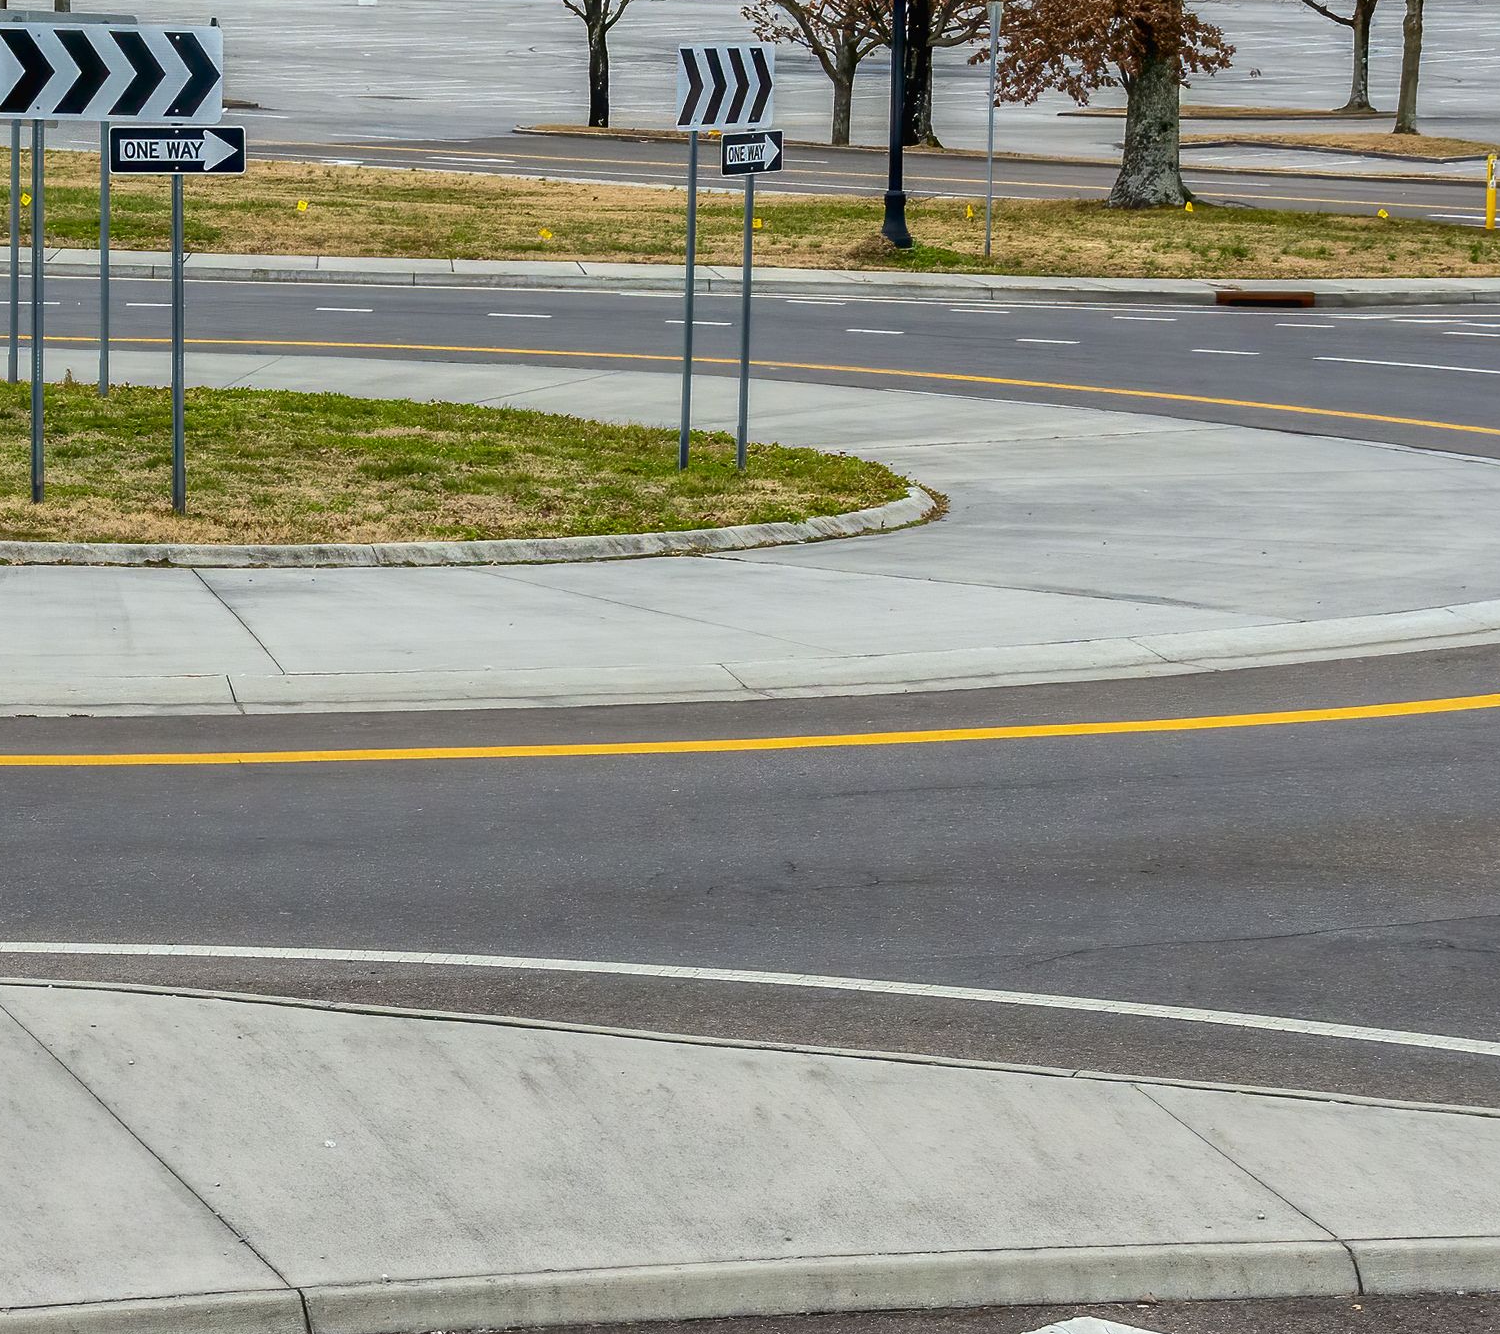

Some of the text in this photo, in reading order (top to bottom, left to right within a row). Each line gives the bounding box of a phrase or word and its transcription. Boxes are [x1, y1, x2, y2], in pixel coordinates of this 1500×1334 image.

[124, 141, 204, 159] ONE WAY
[728, 144, 765, 163] ONE WAY
